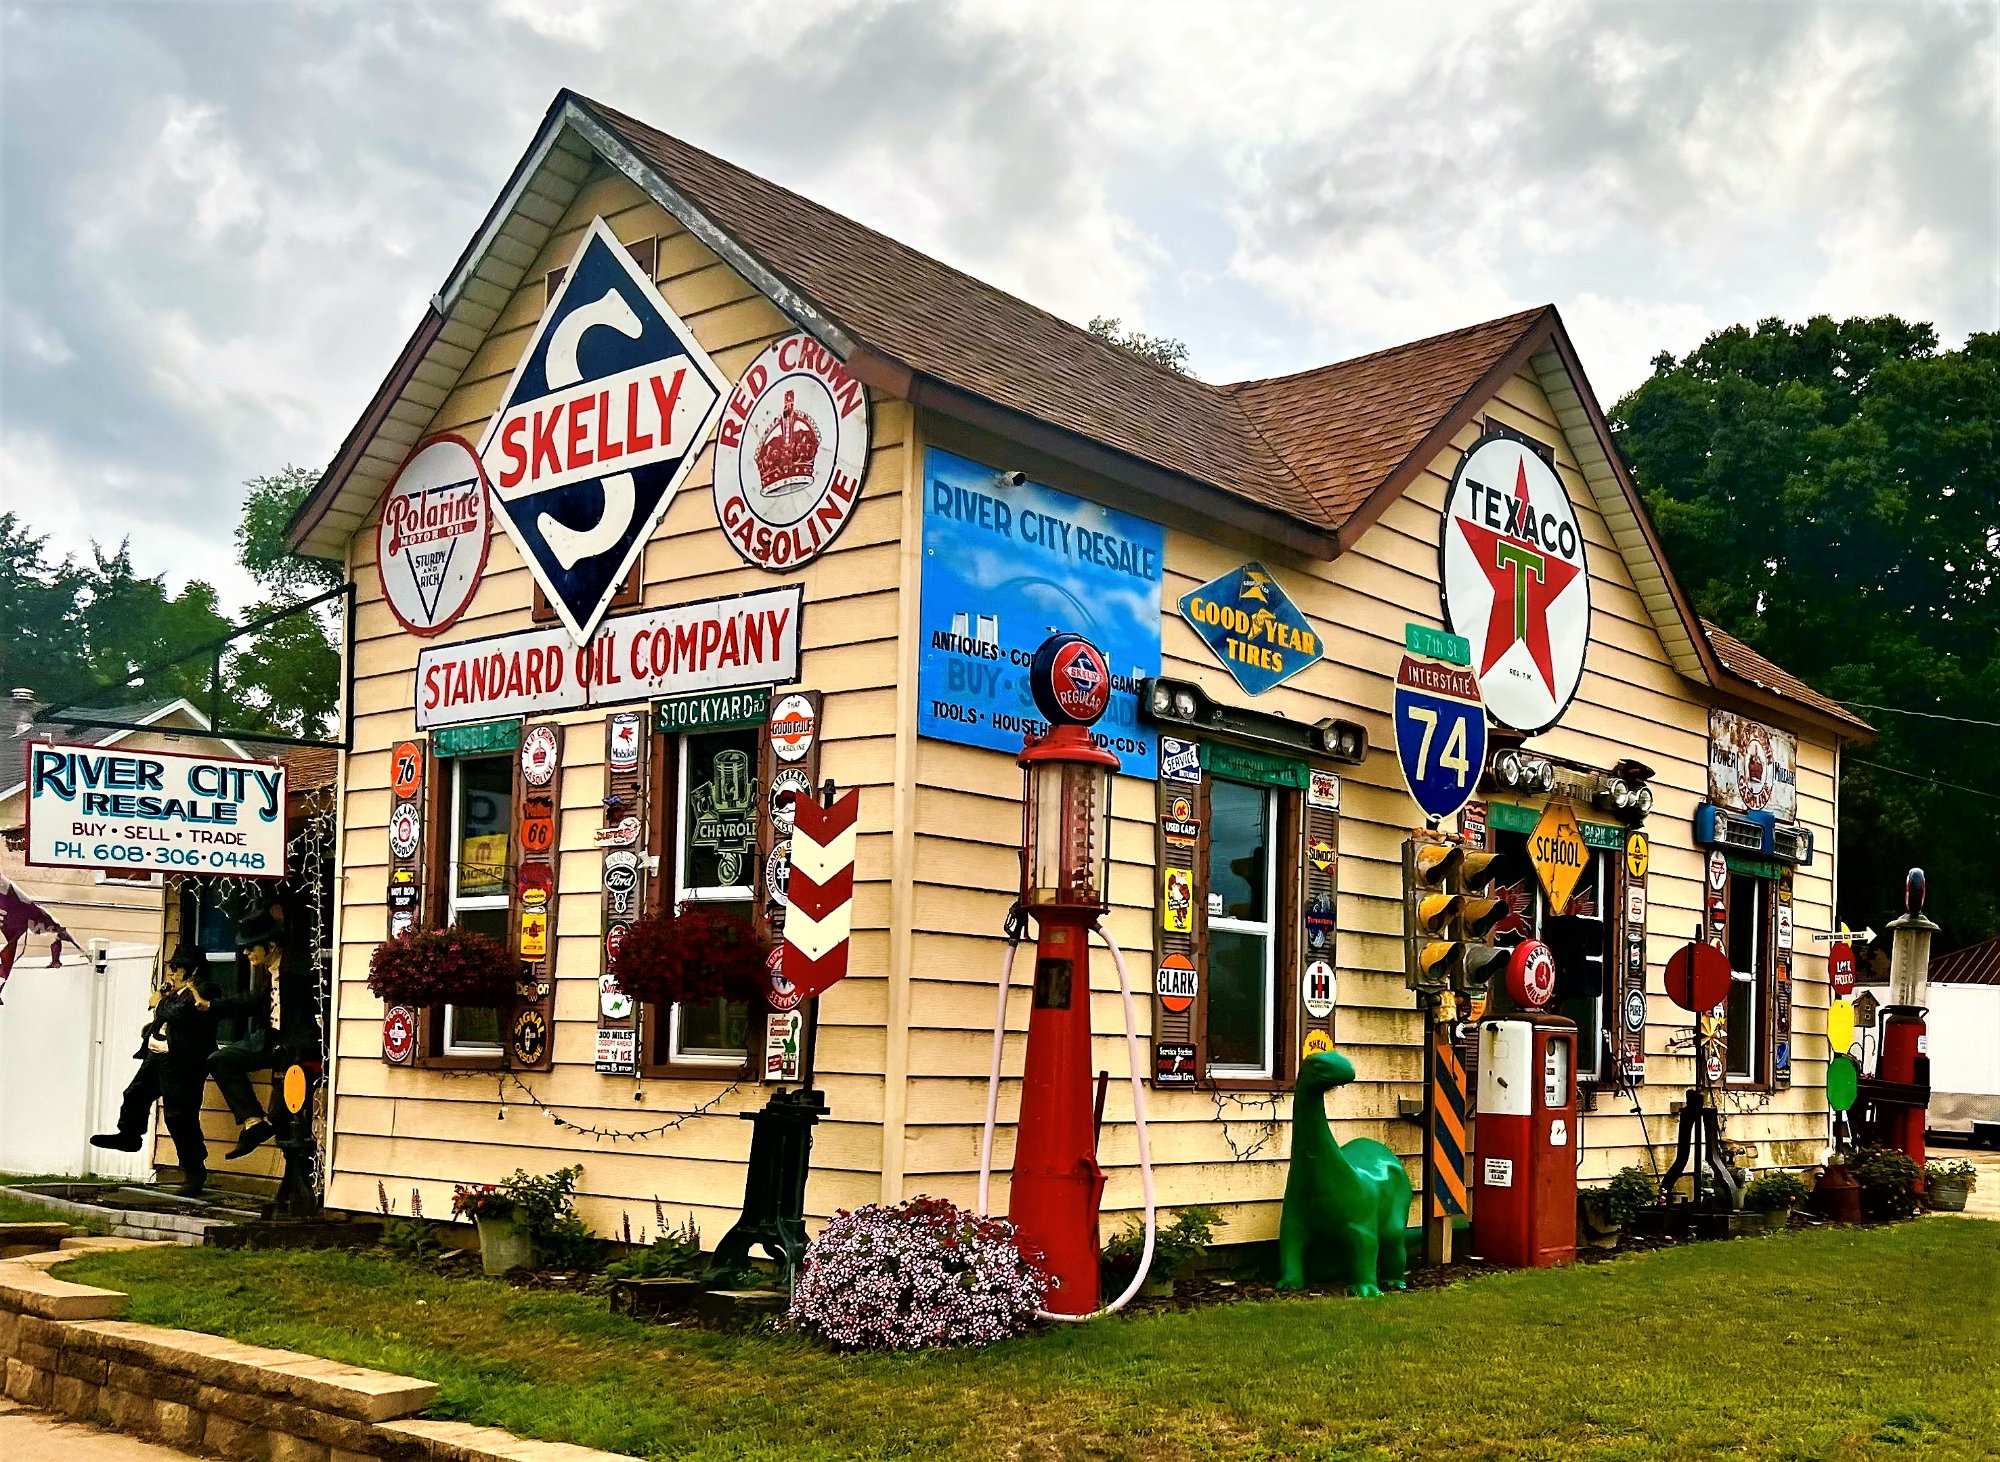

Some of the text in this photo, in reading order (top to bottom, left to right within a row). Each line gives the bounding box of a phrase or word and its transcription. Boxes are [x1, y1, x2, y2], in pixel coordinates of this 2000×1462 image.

[721, 337, 863, 448] RED CROWN
[499, 368, 687, 488] SKELLY
[386, 490, 480, 556] Polarine
[724, 469, 858, 565] GASOLINE
[1466, 478, 1576, 560] TEXACO
[400, 524, 465, 547] MOTOR OIL
[933, 480, 1156, 581] RIVER CITY RESALE
[415, 550, 446, 568] STURDY
[420, 573, 441, 588] RICH
[1497, 539, 1544, 645] T
[932, 630, 998, 662] ANTIQUES
[1226, 637, 1283, 673] TIRES
[1426, 634, 1443, 654] 7th
[424, 607, 790, 710] STANDARD OIL COMPANY
[949, 660, 1003, 698] BUY
[1071, 668, 1098, 680] SKELLY
[1408, 665, 1471, 695] INTERSTATE
[788, 700, 800, 708] THAT
[1060, 690, 1102, 710] REGULAR
[932, 700, 977, 724] TOOLS
[773, 719, 812, 735] GOOD GULF
[778, 744, 805, 752] GASOLINE
[1408, 706, 1469, 787] 74
[1713, 742, 1736, 769] POWER
[395, 754, 416, 786] 76
[1167, 750, 1194, 771] SERVICE
[524, 762, 553, 784] GASOLINE
[773, 770, 810, 790] BUFFALO
[33, 750, 282, 822] RIVER CITY
[83, 793, 238, 825] RESALE
[393, 806, 419, 827] ATLANTIC
[72, 822, 247, 846] BUY SELL TRADE
[528, 823, 548, 845] 66
[1166, 821, 1196, 835] USED CARS
[54, 841, 86, 859] PH.
[392, 836, 417, 856] GASOLINE
[1309, 847, 1335, 862] SUNOCO
[1537, 835, 1581, 868] SCHOOL
[461, 866, 503, 881] MOPAR
[607, 870, 634, 887] Ford
[767, 845, 782, 893] STANDARD
[1160, 971, 1195, 994] CLARK
[769, 992, 799, 1007] SERVICE
[515, 1011, 545, 1037] SIGNAL
[599, 1031, 632, 1040] 300 MILES
[1309, 1040, 1327, 1052] SHELL
[515, 1042, 543, 1064] GASOLINE
[621, 1050, 632, 1061] ICE
